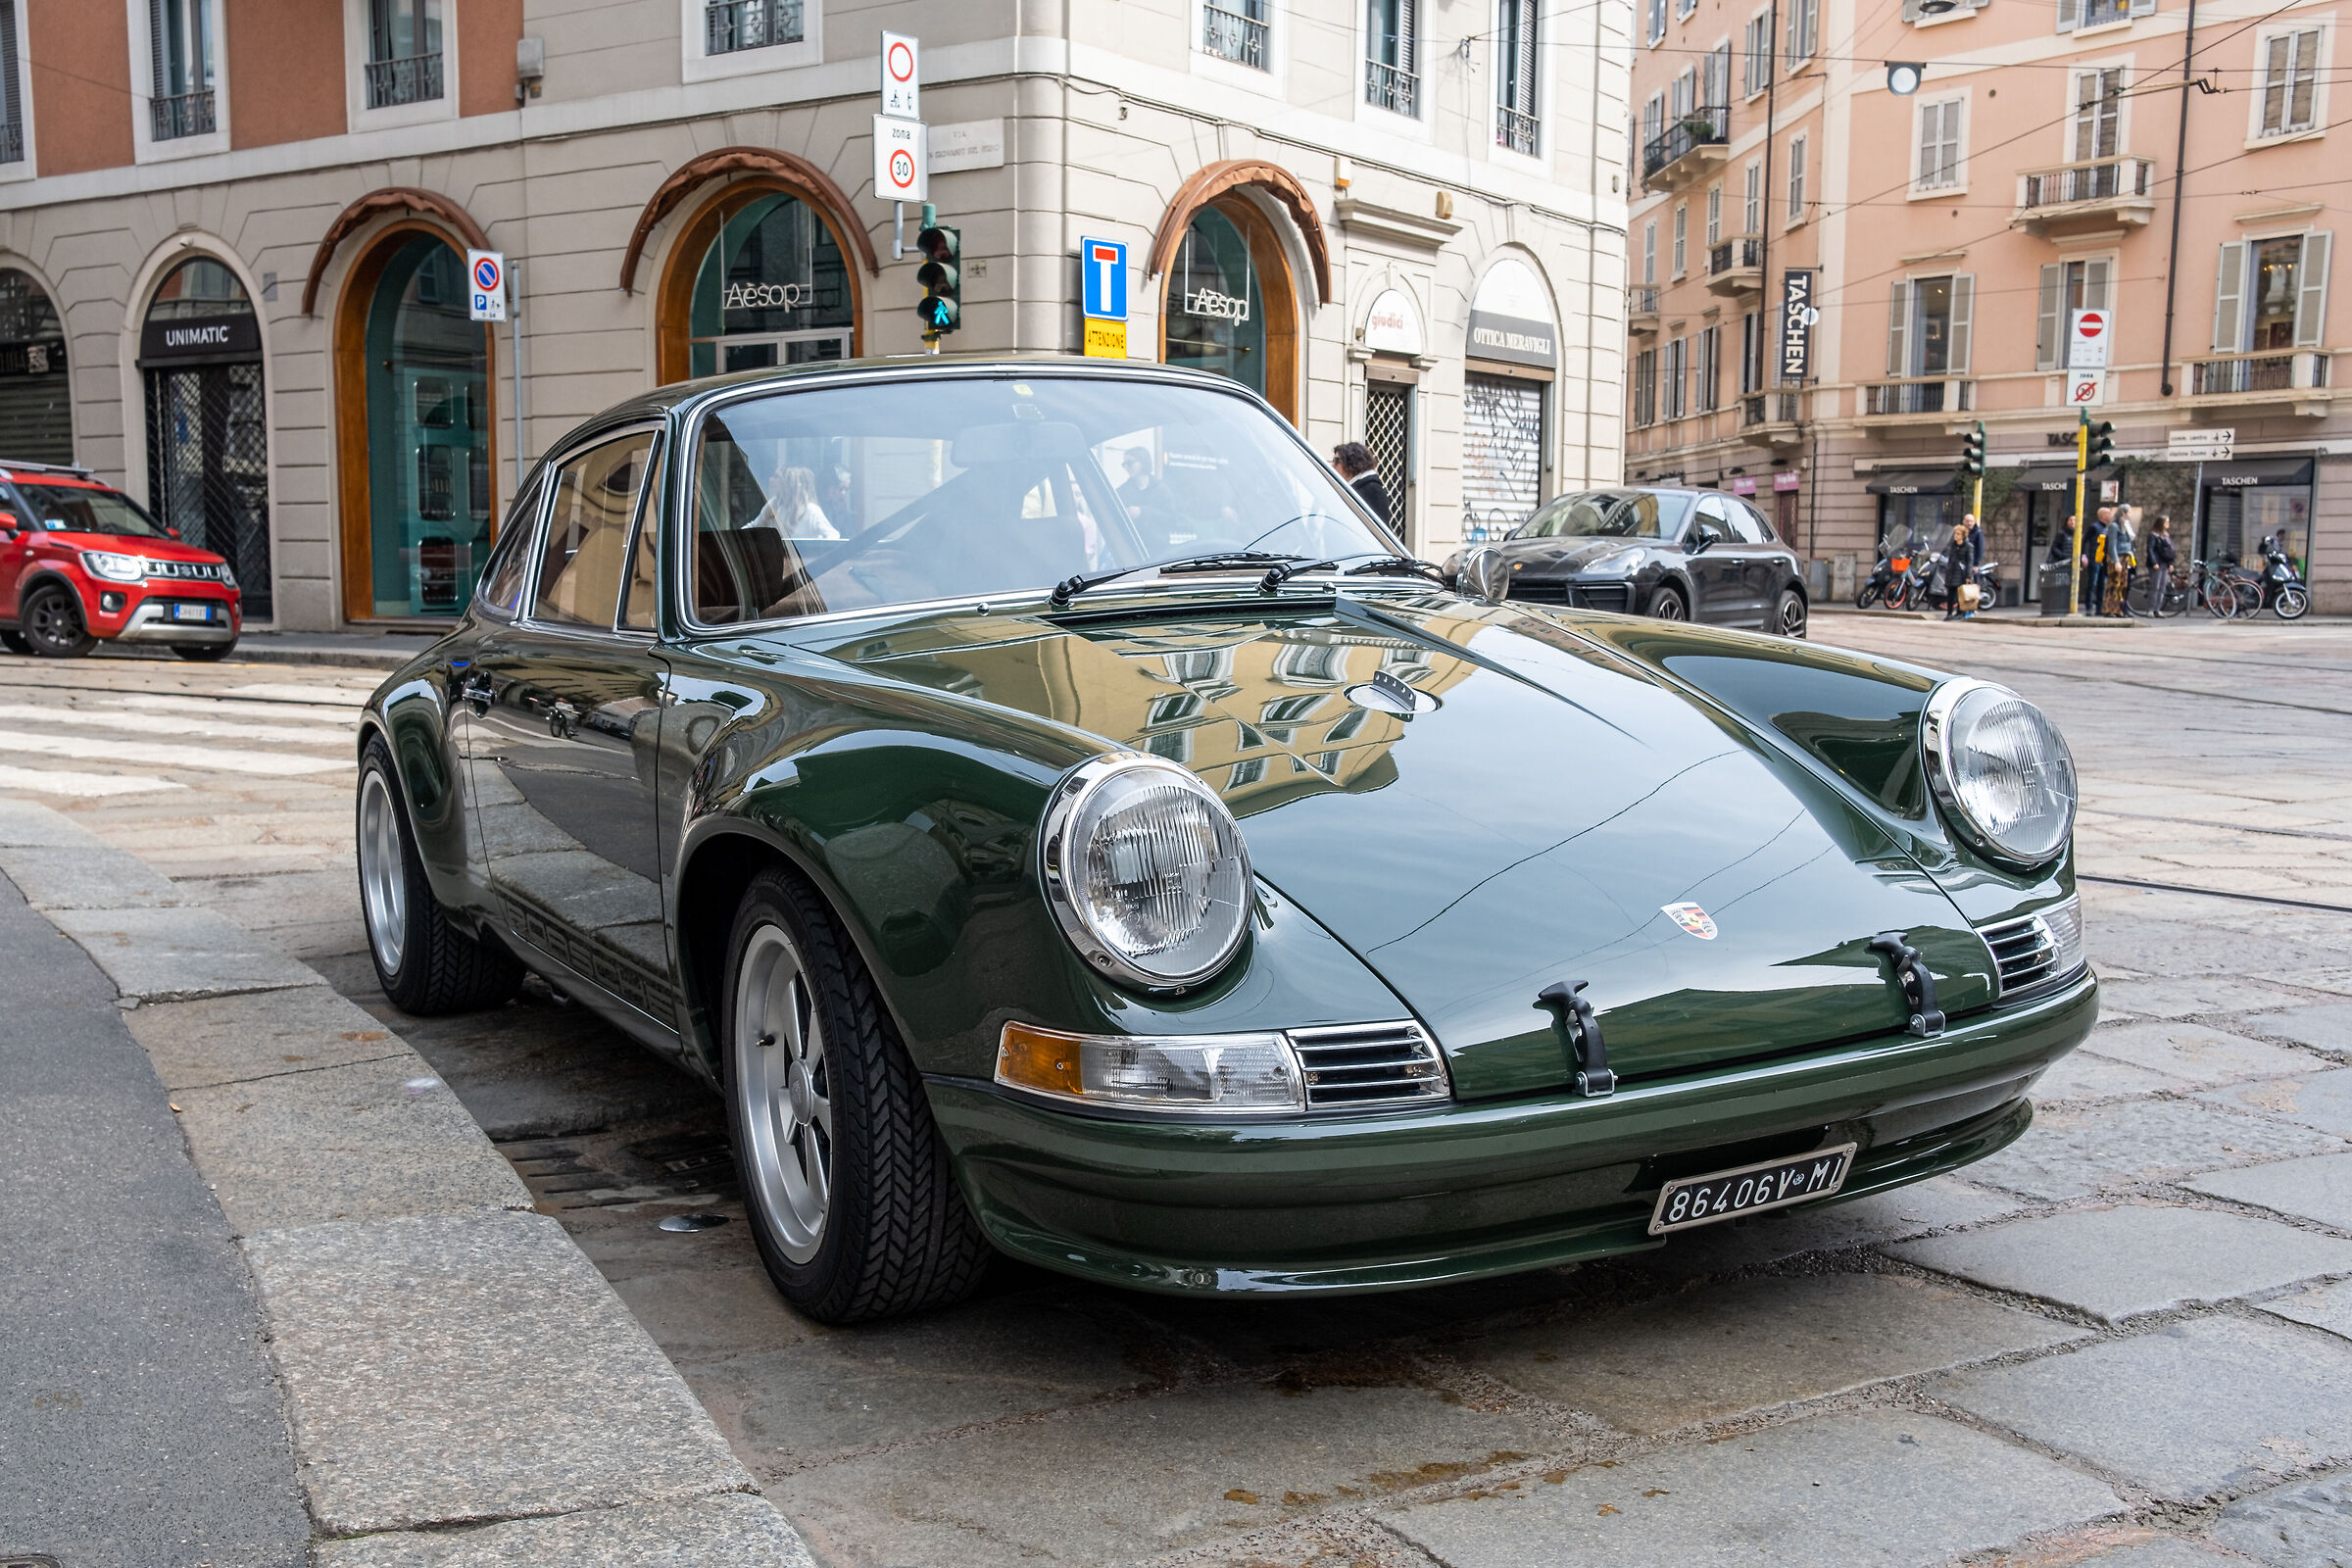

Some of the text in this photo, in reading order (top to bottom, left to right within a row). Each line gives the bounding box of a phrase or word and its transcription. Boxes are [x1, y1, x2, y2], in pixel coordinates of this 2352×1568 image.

[892, 128, 910, 139] zona
[896, 161, 908, 176] 30
[1371, 311, 1403, 330] giudici
[1786, 274, 1808, 373] TASCHEN
[166, 325, 228, 347] UNIMATIC
[1088, 329, 1125, 349] ATTENZIONE
[1473, 327, 1551, 355] OTTICA MERAVIGLI
[2046, 432, 2079, 447] TASC
[1889, 485, 1918, 494] TASCHEN
[2222, 476, 2258, 486] TASCHEN
[504, 899, 677, 1027] PORSCHE
[1668, 1157, 1842, 1223] 86406V MI
